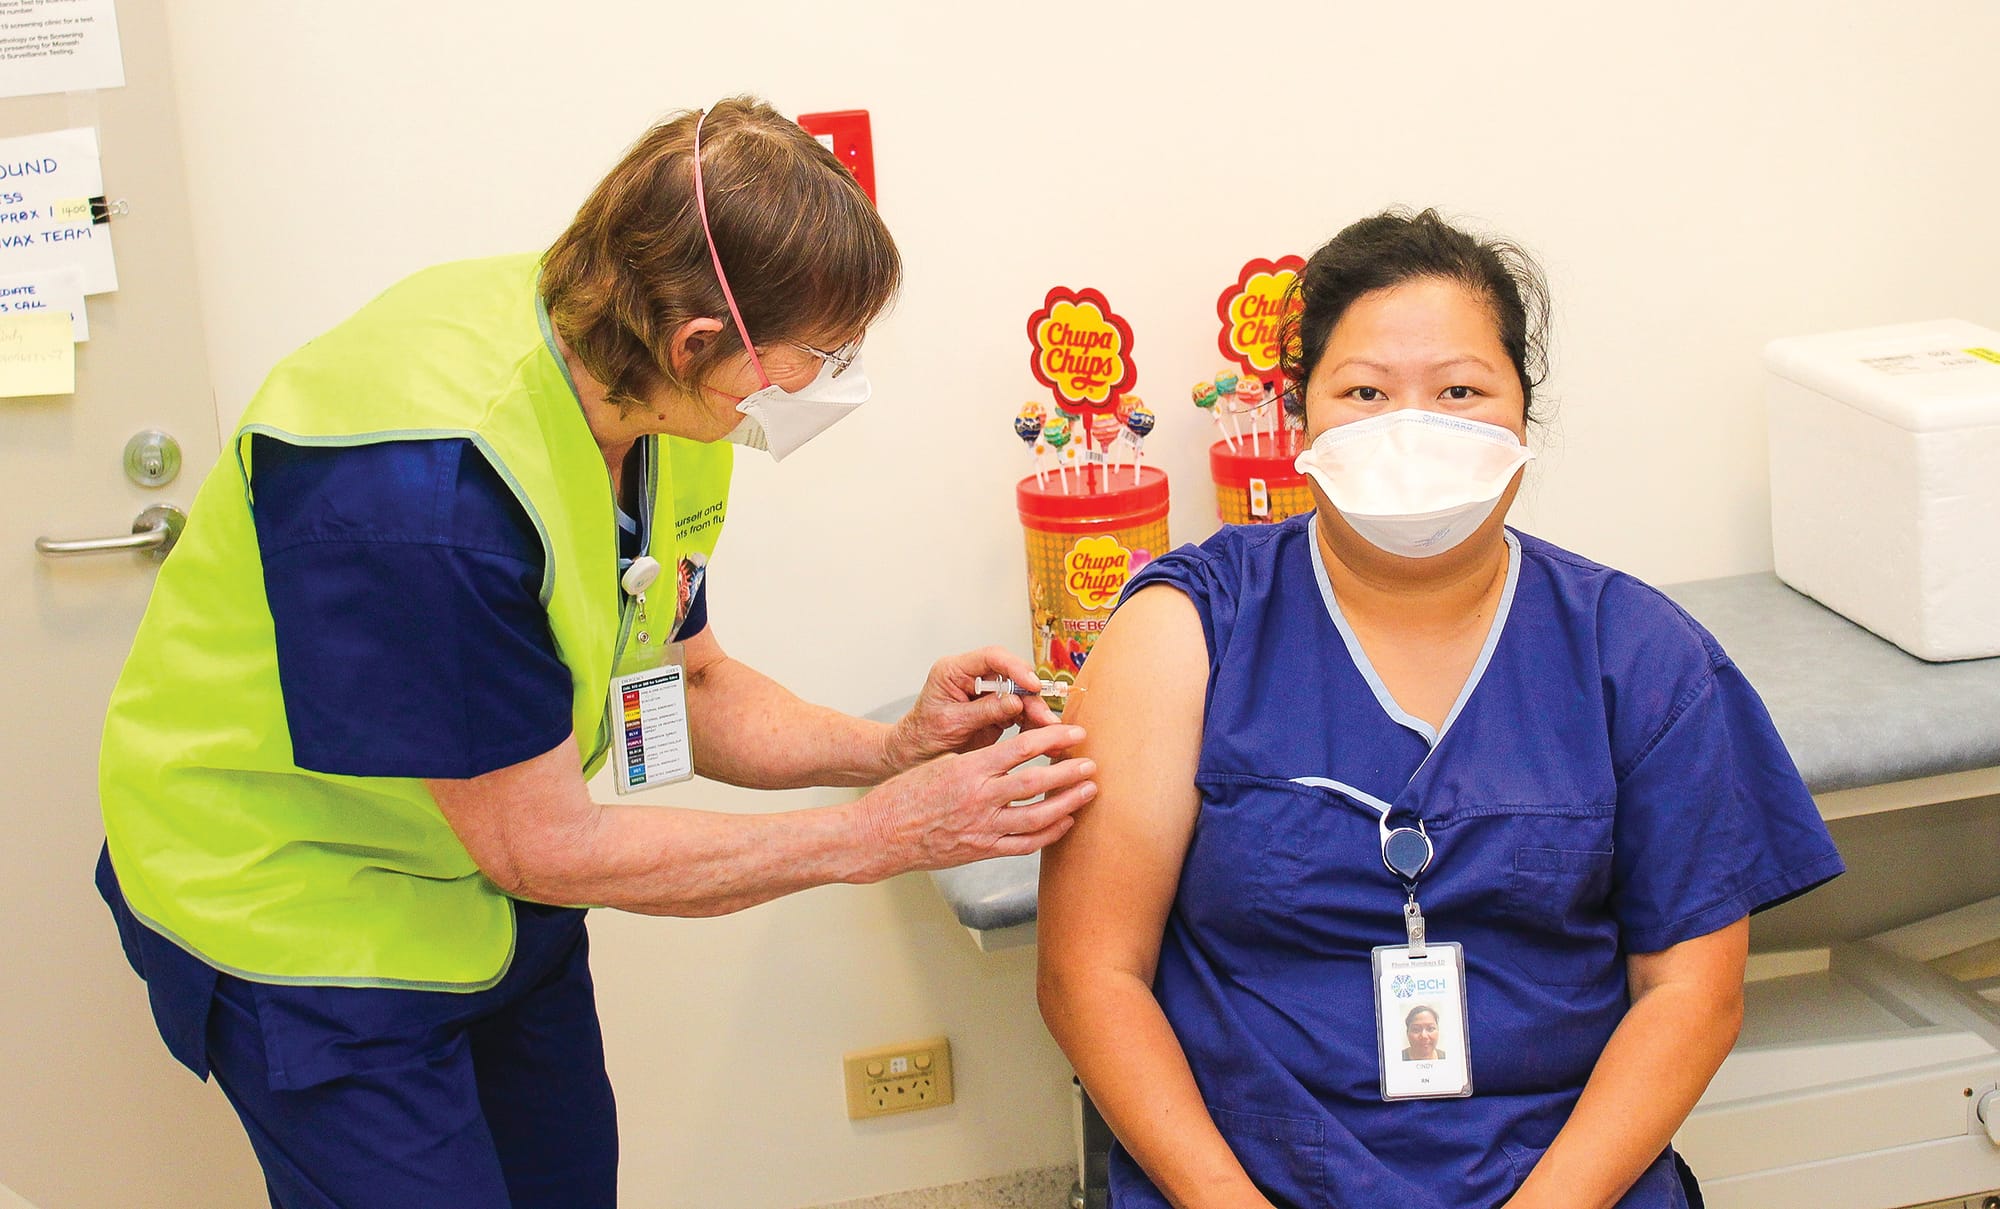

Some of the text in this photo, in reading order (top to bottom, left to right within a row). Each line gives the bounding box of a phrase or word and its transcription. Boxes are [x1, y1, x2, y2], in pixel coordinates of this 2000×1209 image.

[10, 21, 43, 29] screening
[50, 32, 84, 40] Screening
[41, 228, 91, 242] TEAM
[15, 300, 47, 310] CALL
[1047, 322, 1113, 350] Chupa
[1046, 347, 1113, 386] Chups
[704, 500, 723, 516] and
[690, 520, 711, 534] from
[712, 515, 725, 525] flu
[1072, 553, 1125, 573] Chupa
[1070, 571, 1125, 599] Chups
[1063, 620, 1086, 632] THE
[1417, 978, 1446, 990] BCH
